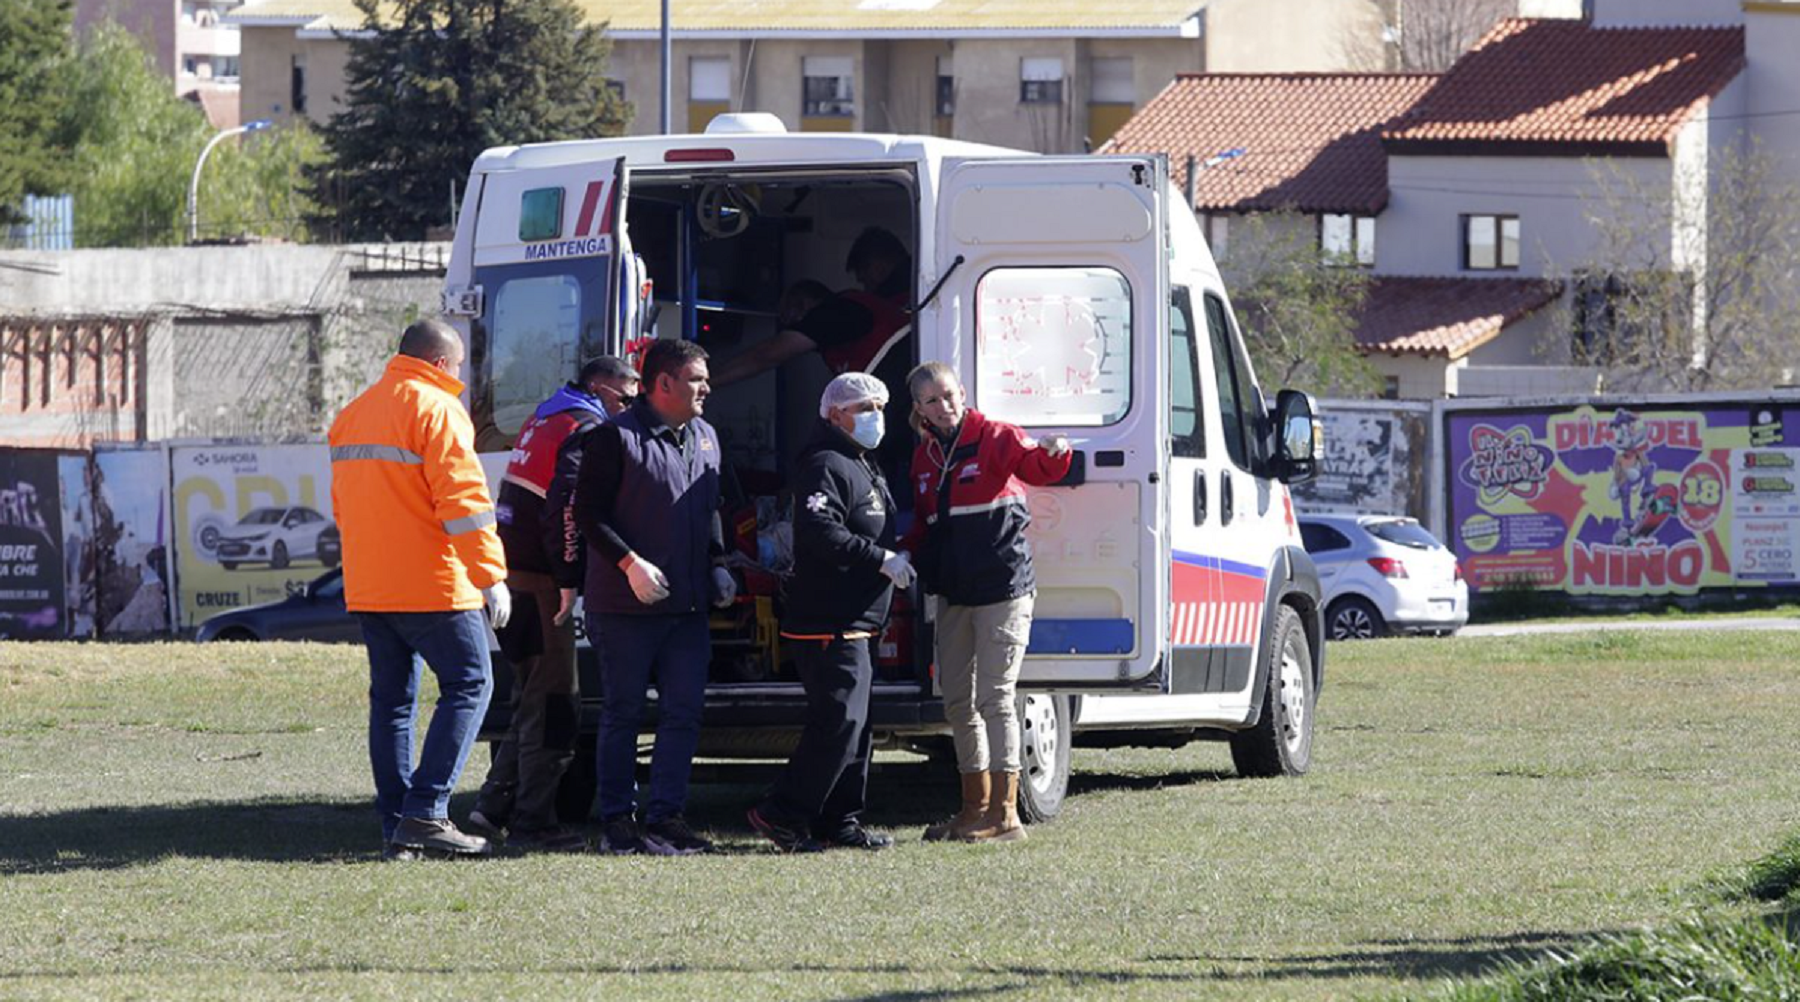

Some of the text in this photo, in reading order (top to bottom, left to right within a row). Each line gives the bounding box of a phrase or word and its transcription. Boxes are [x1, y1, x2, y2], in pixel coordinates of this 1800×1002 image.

[525, 238, 607, 260] MANTENGA
[1645, 418, 1703, 449] DEL
[1683, 474, 1720, 505] 18
[0, 545, 37, 561] BRE
[1573, 542, 1702, 586] NIÑO
[196, 592, 240, 607] CRUZE
